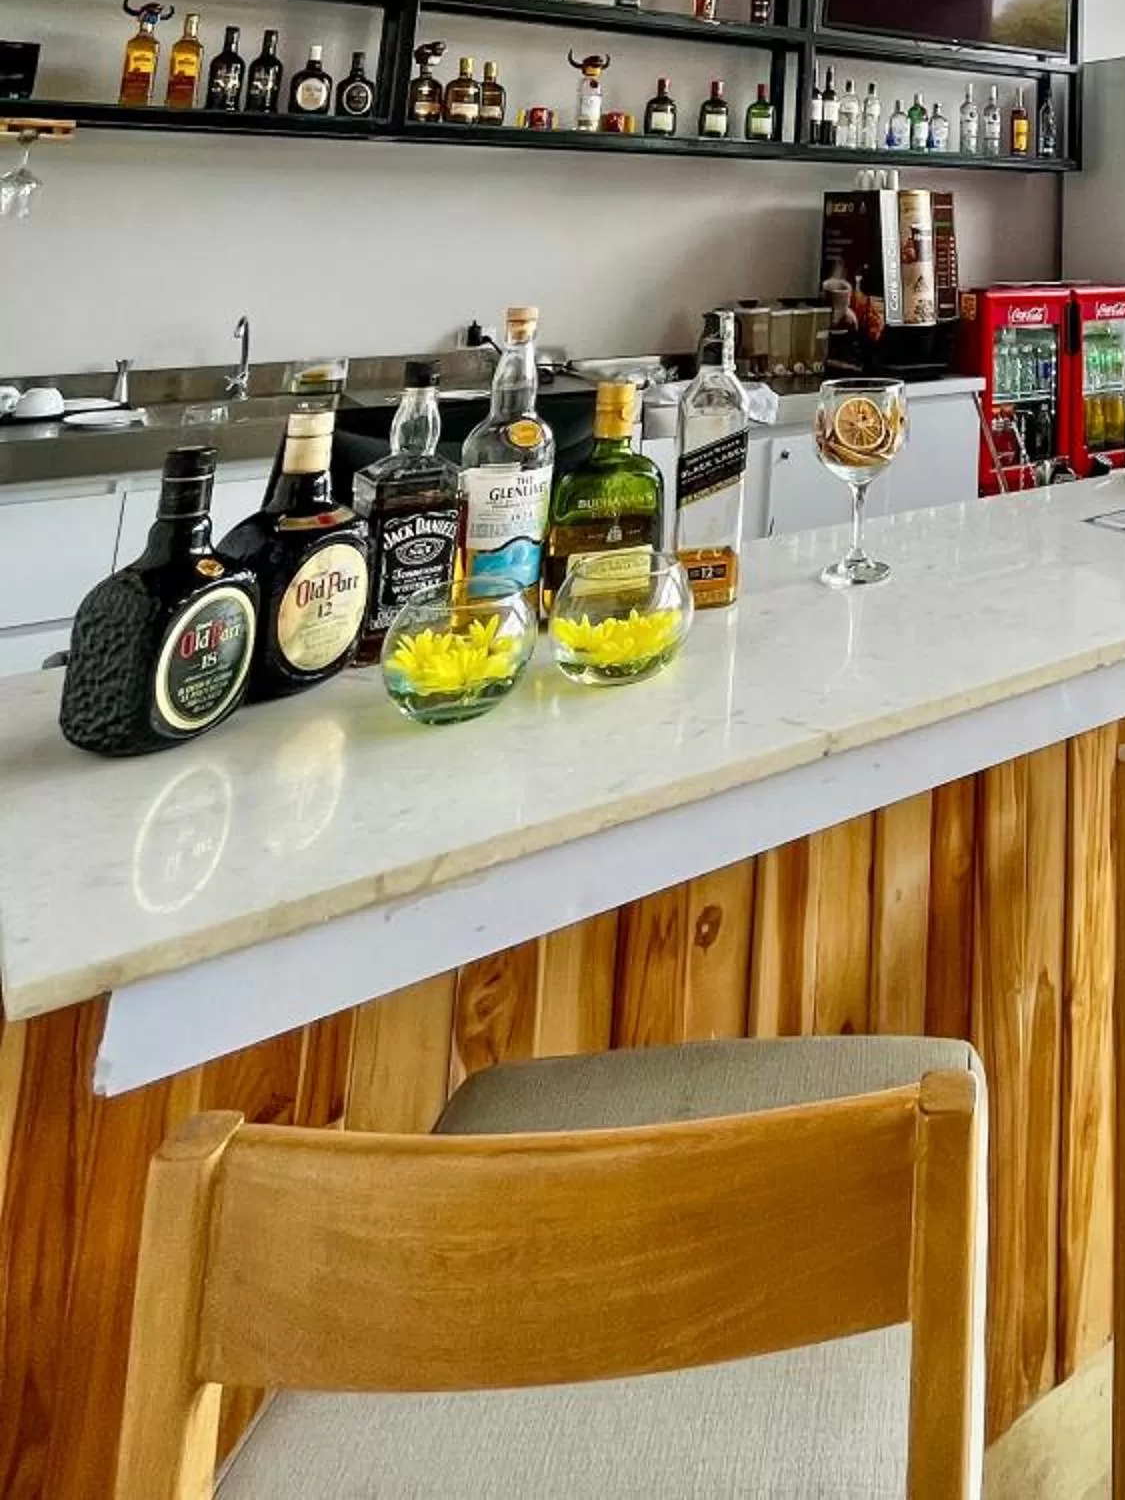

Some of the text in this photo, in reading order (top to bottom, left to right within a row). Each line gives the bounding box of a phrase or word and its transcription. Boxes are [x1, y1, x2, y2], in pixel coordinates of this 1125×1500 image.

[383, 523, 415, 550] JACK
[296, 571, 359, 608] Old Parr
[317, 601, 333, 619] 12
[180, 620, 241, 658] Old Parr
